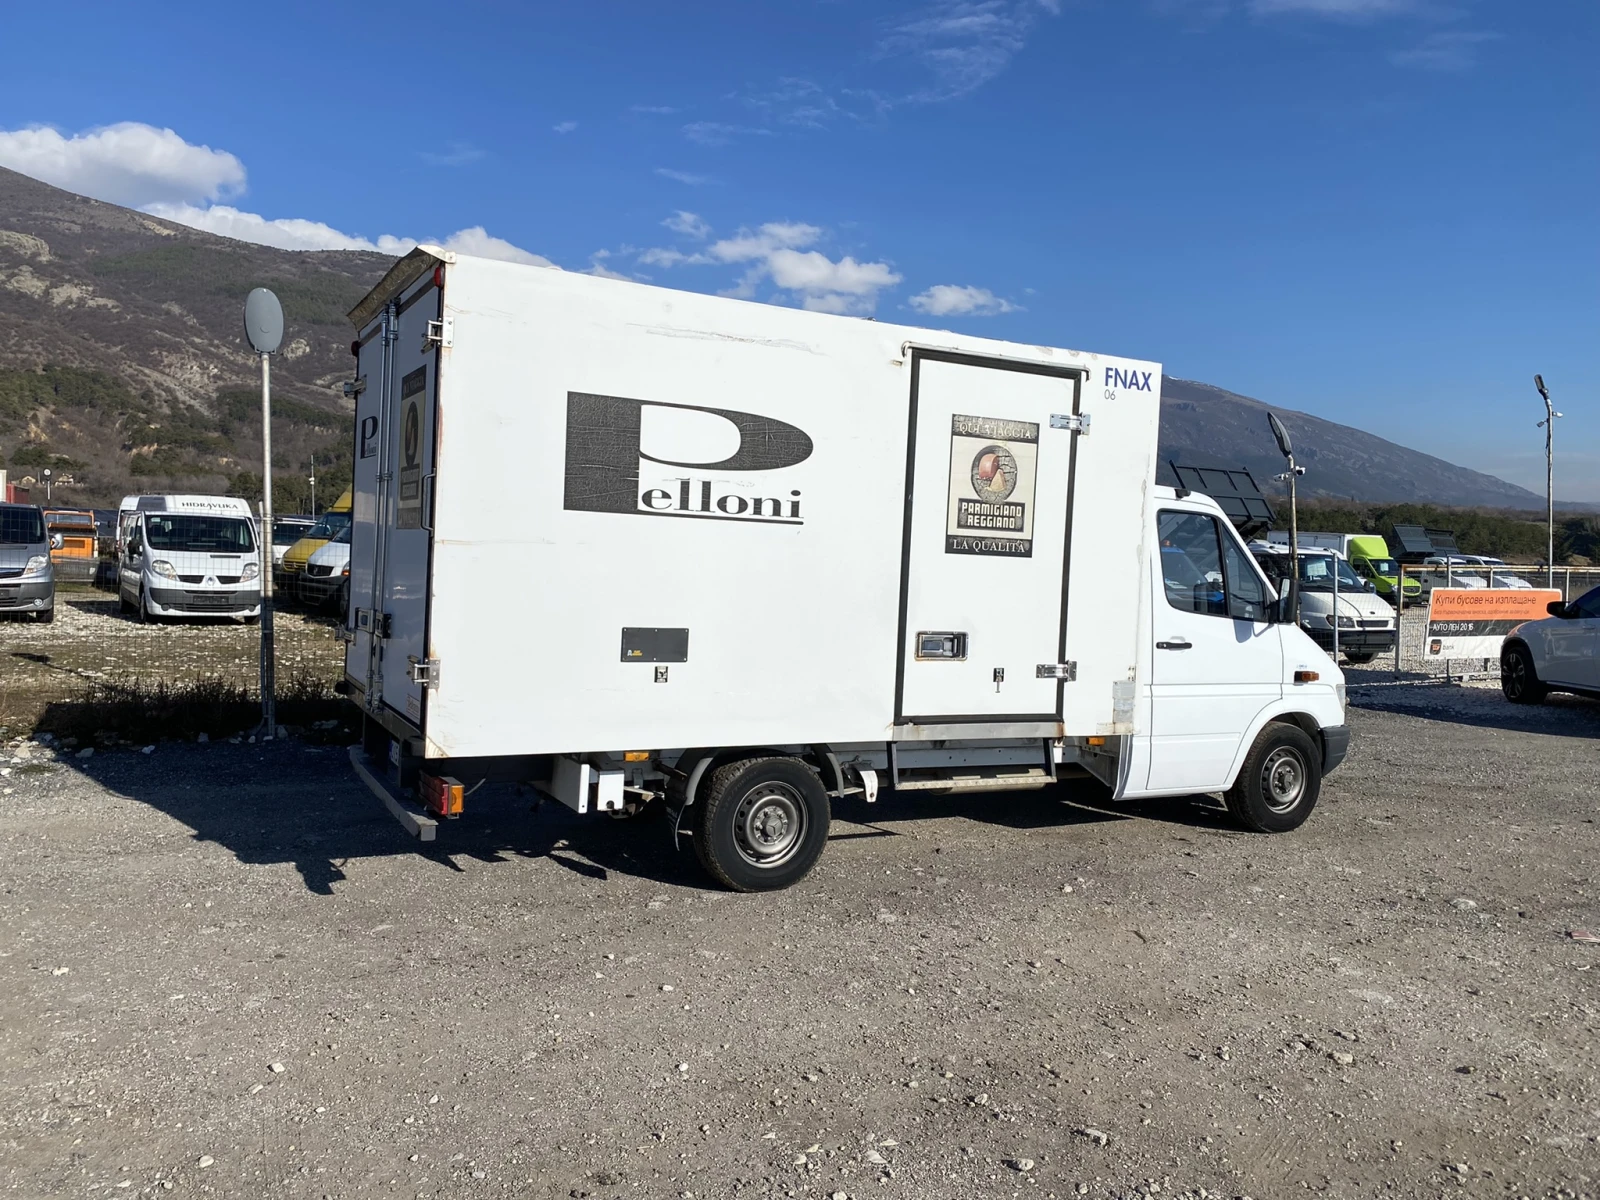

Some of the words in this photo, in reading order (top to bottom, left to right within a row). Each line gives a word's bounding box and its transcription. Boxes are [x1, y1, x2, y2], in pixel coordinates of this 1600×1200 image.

[1105, 367, 1152, 392] FNAX
[1104, 389, 1116, 400] 06
[563, 391, 814, 525] Pelloni
[961, 502, 1022, 517] PARMIGIANO
[967, 514, 1015, 529] REGGIANO
[953, 539, 969, 550] LA
[1435, 594, 1455, 606] Купи
[1456, 594, 1484, 606] бусове
[1485, 596, 1494, 605] на
[1495, 596, 1537, 606] изплащане
[1433, 623, 1448, 631] АУТО
